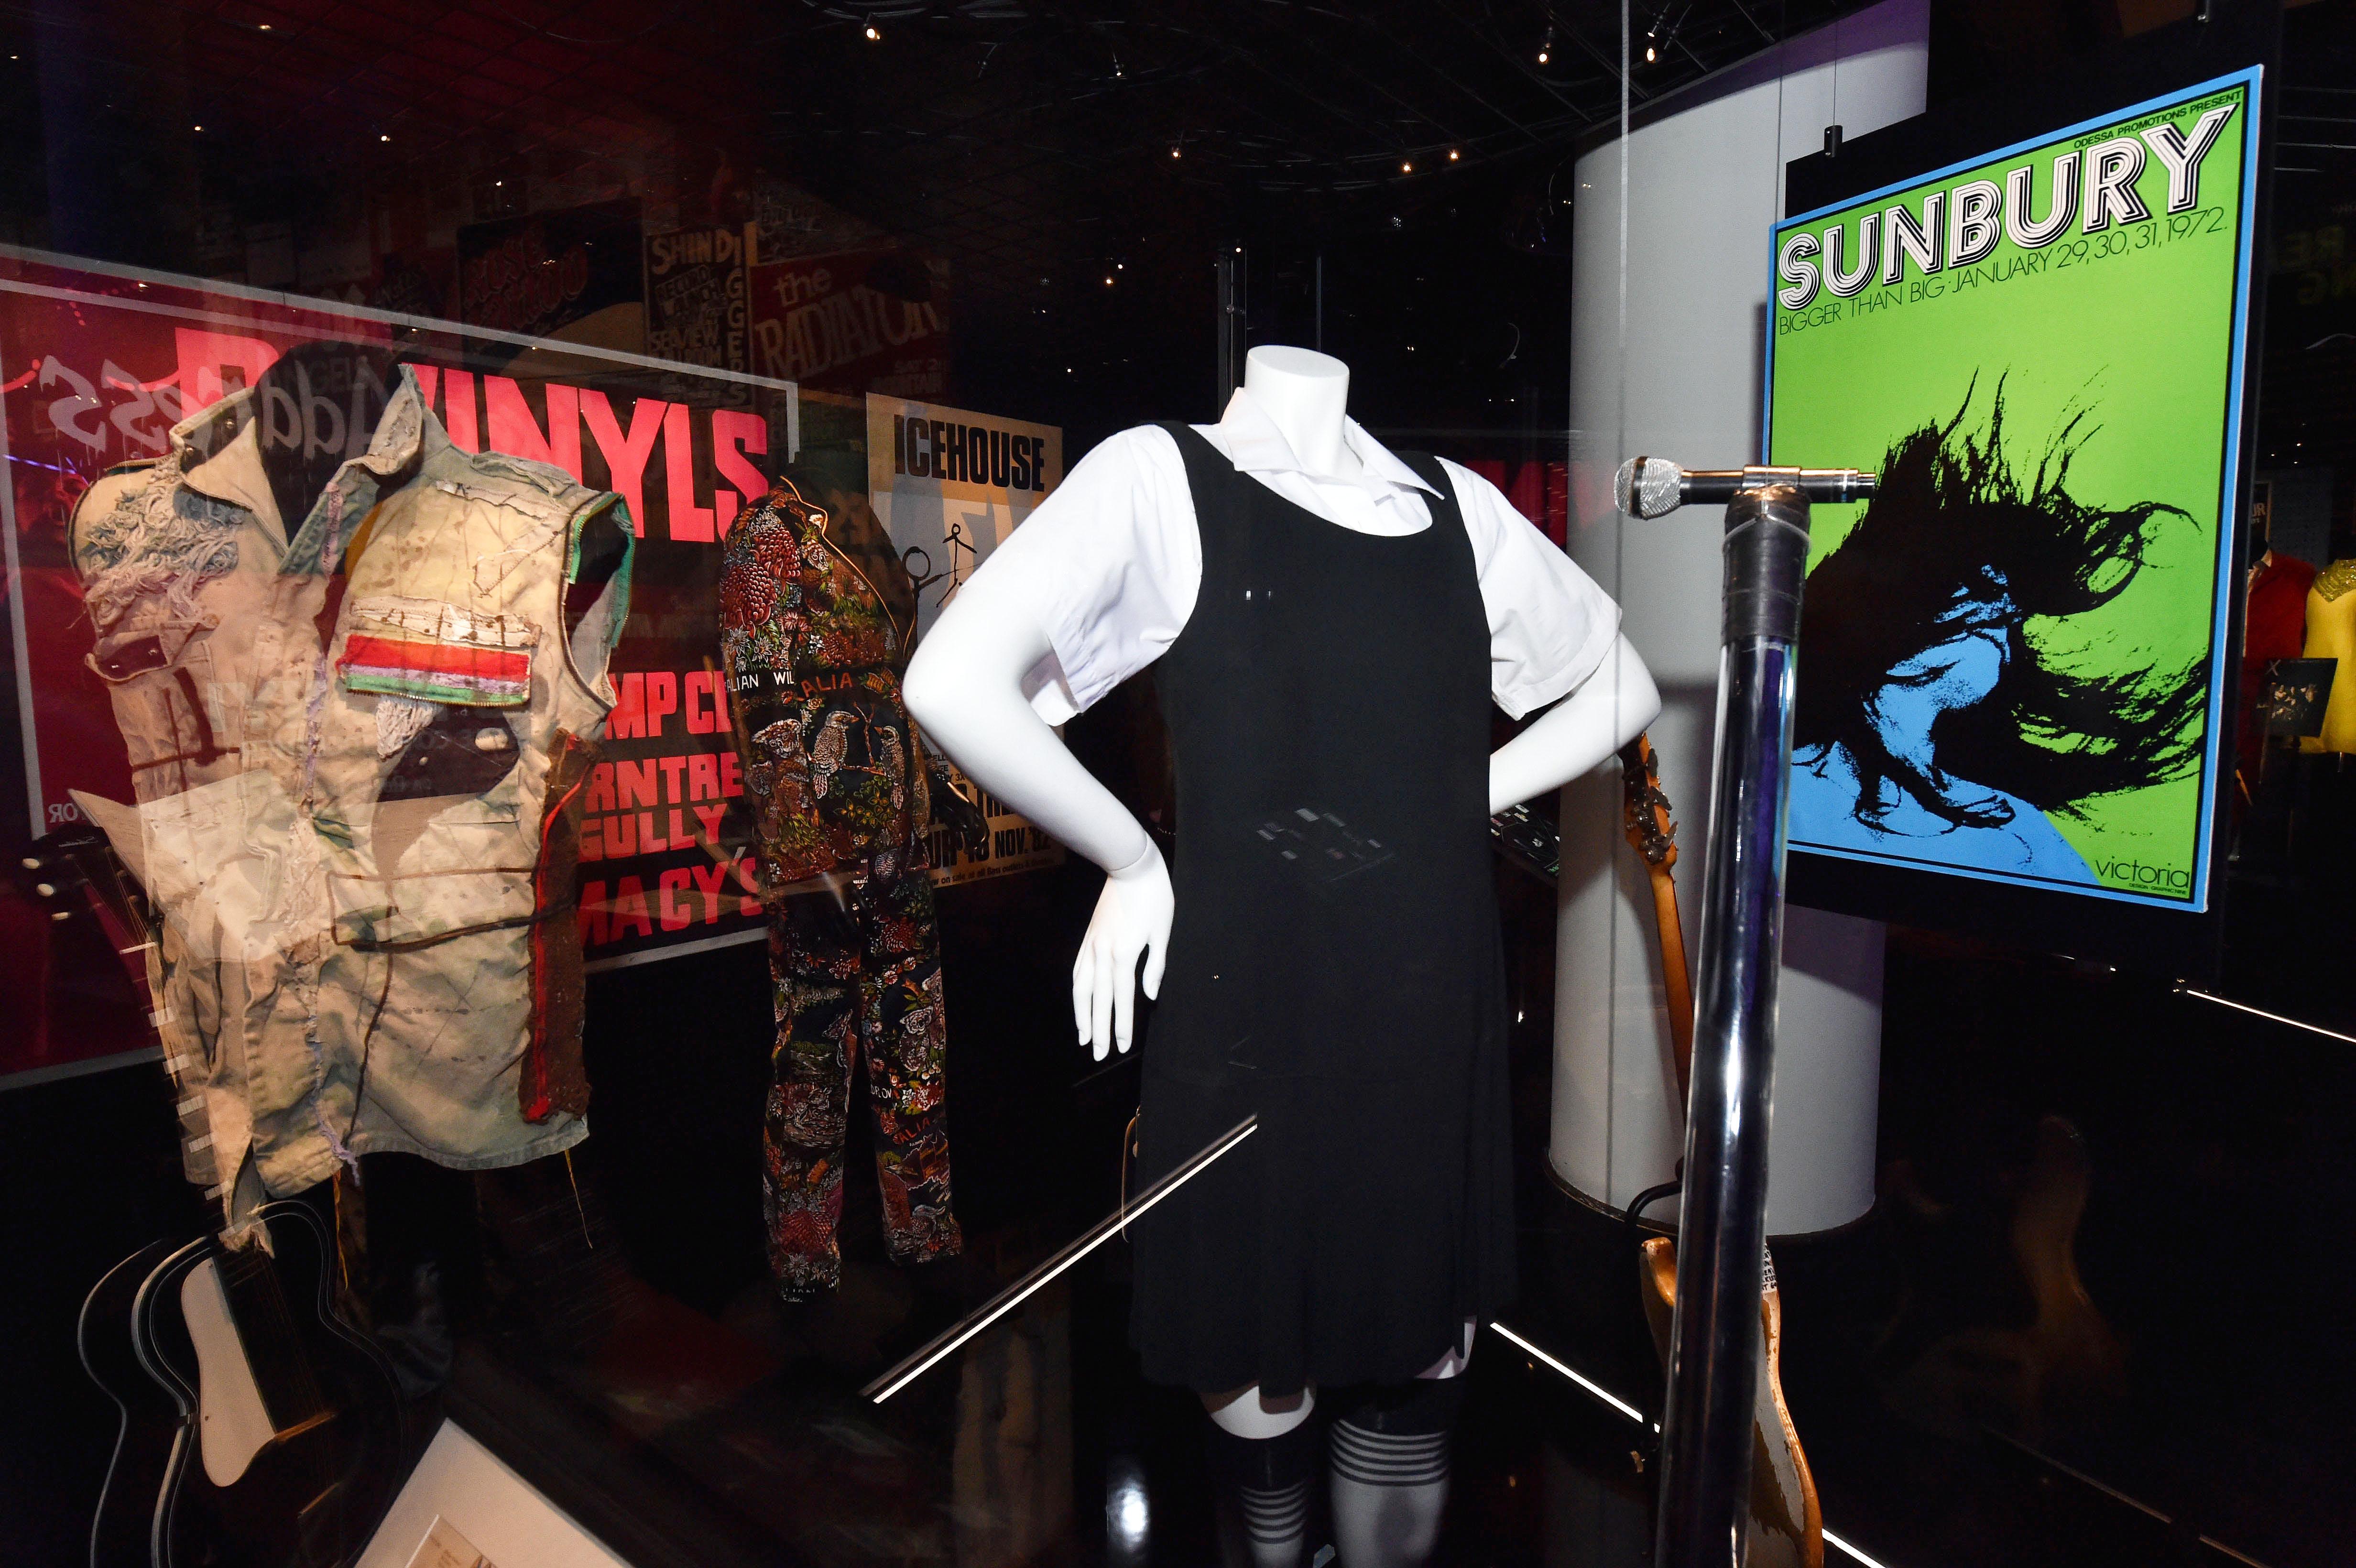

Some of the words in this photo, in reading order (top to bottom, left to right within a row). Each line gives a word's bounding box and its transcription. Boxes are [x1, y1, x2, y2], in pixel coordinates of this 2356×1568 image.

[2074, 131, 2113, 149] ODESSA
[2117, 109, 2187, 136] PROMOTIONS
[2190, 90, 2242, 114] PRESENT
[1778, 102, 2240, 311] SUNBURY
[773, 269, 832, 307] the
[1780, 303, 1842, 335] BIGGER
[1849, 285, 1903, 317] THAN
[1952, 248, 2053, 293] JANUARY
[894, 414, 1045, 492] ICEHOUSE
[578, 803, 728, 863] GULLY
[994, 827, 1028, 859] NOV.
[941, 875, 950, 884] on
[2095, 855, 2190, 888] victoria
